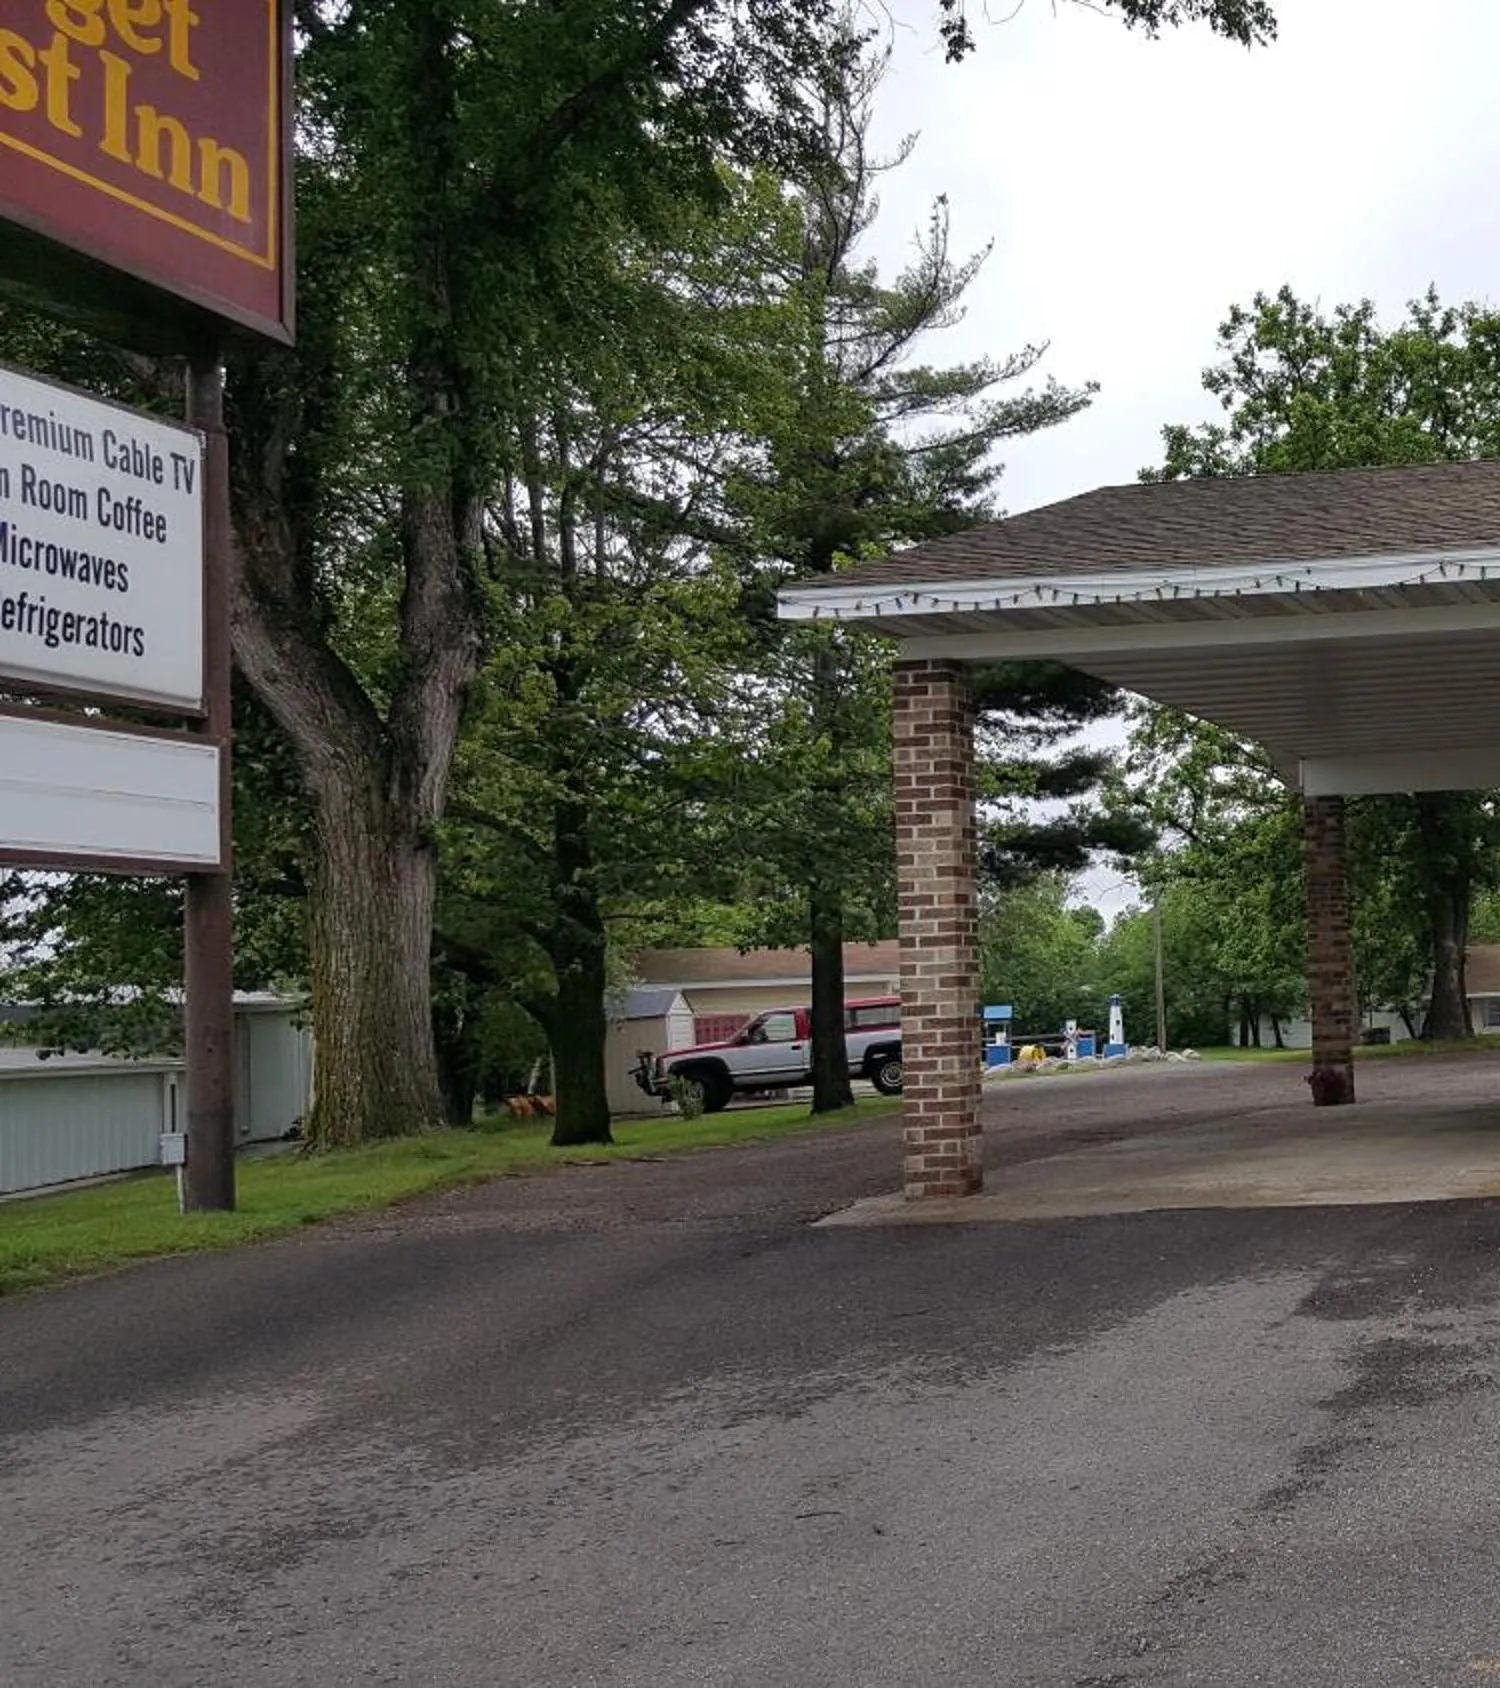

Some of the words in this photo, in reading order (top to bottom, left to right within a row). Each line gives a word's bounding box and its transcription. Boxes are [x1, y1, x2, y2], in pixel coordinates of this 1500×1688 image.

[99, 49, 252, 224] Inn
[102, 429, 164, 485] Cable
[169, 451, 195, 495] TV
[21, 463, 88, 521] Room
[97, 487, 167, 544] Coffee
